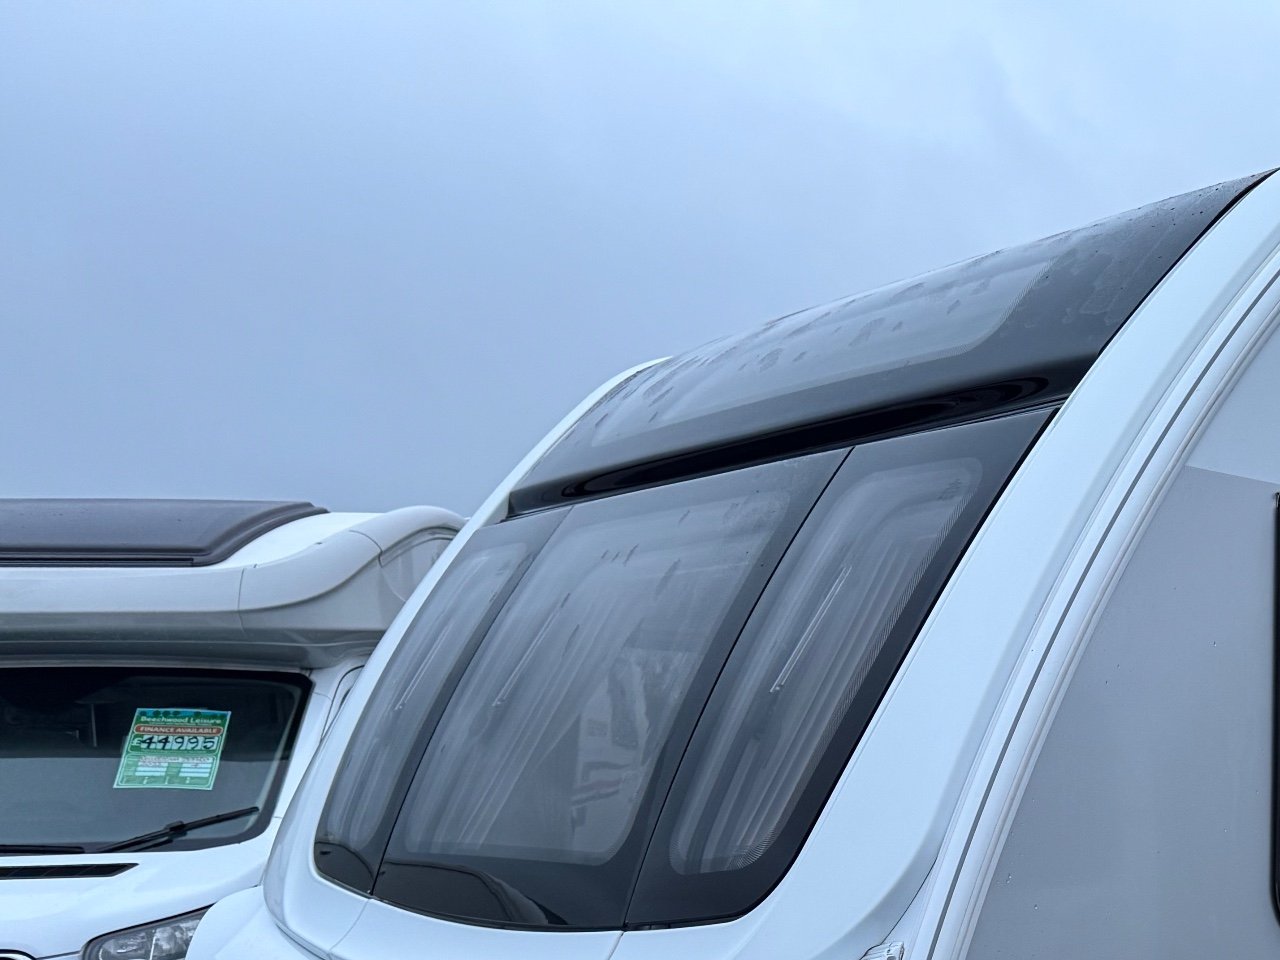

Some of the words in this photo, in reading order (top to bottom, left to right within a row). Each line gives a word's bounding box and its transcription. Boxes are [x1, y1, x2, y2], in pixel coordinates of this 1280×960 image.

[190, 716, 221, 724] Leisure
[140, 726, 174, 734] FINANCE
[175, 727, 218, 735] AVAILABLE
